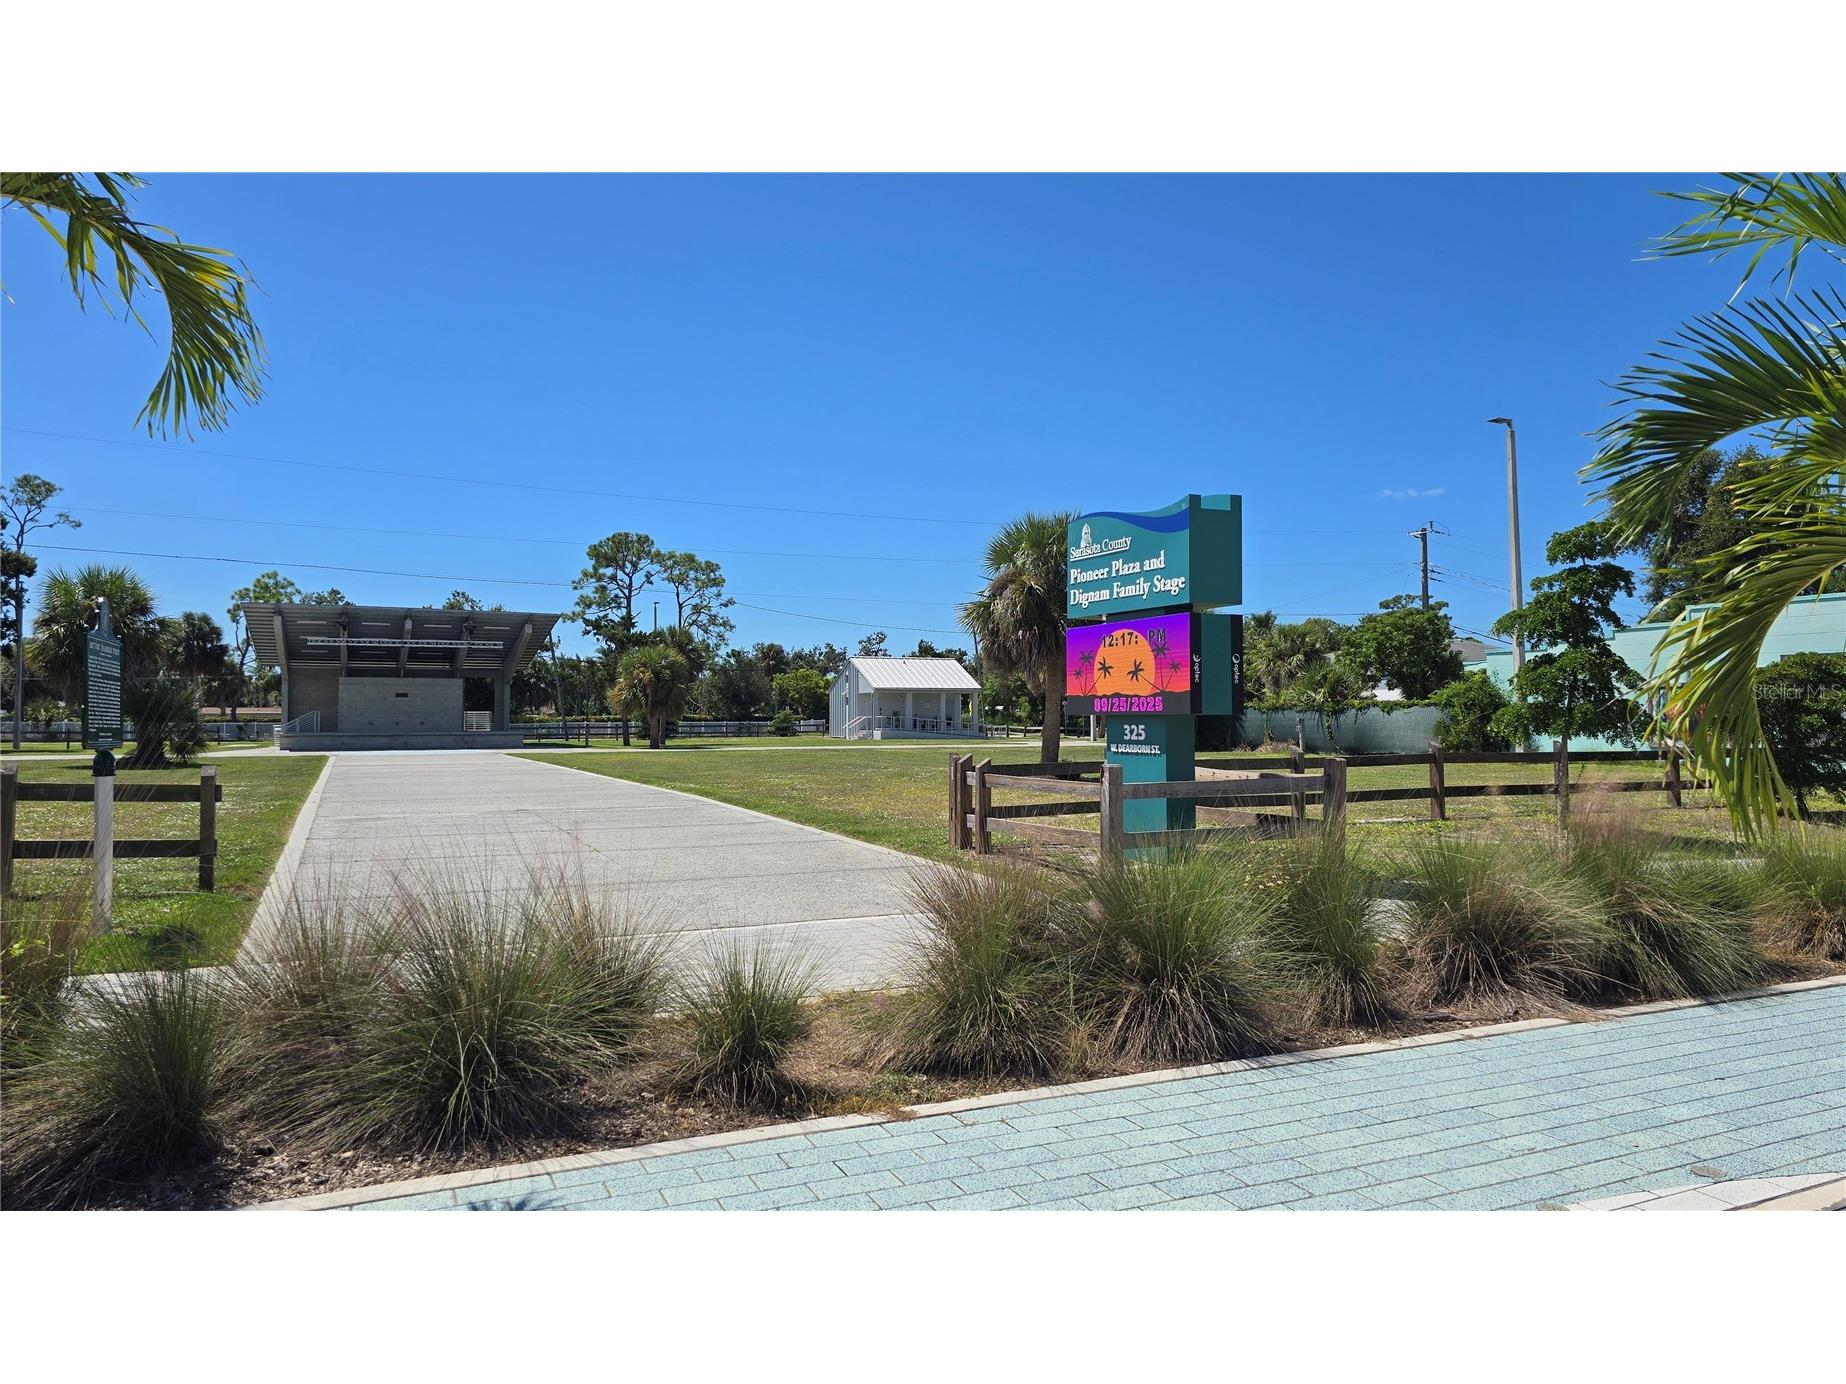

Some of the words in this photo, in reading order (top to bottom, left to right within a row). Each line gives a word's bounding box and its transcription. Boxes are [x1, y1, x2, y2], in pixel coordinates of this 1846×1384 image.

[1070, 543, 1101, 558] Sarasota
[1102, 536, 1132, 551] County
[1070, 567, 1109, 585] Pioneer
[1111, 559, 1141, 577] Plaza
[1143, 549, 1165, 571] and
[1070, 589, 1110, 609] Dignam
[1112, 577, 1151, 599] Family
[1153, 575, 1186, 595] Stage
[1148, 628, 1166, 642] PM
[1093, 696, 1163, 712] 09/25/2025
[1123, 724, 1146, 741] 325
[1118, 744, 1151, 754] DEARBORN
[1151, 745, 1161, 754] ST.
